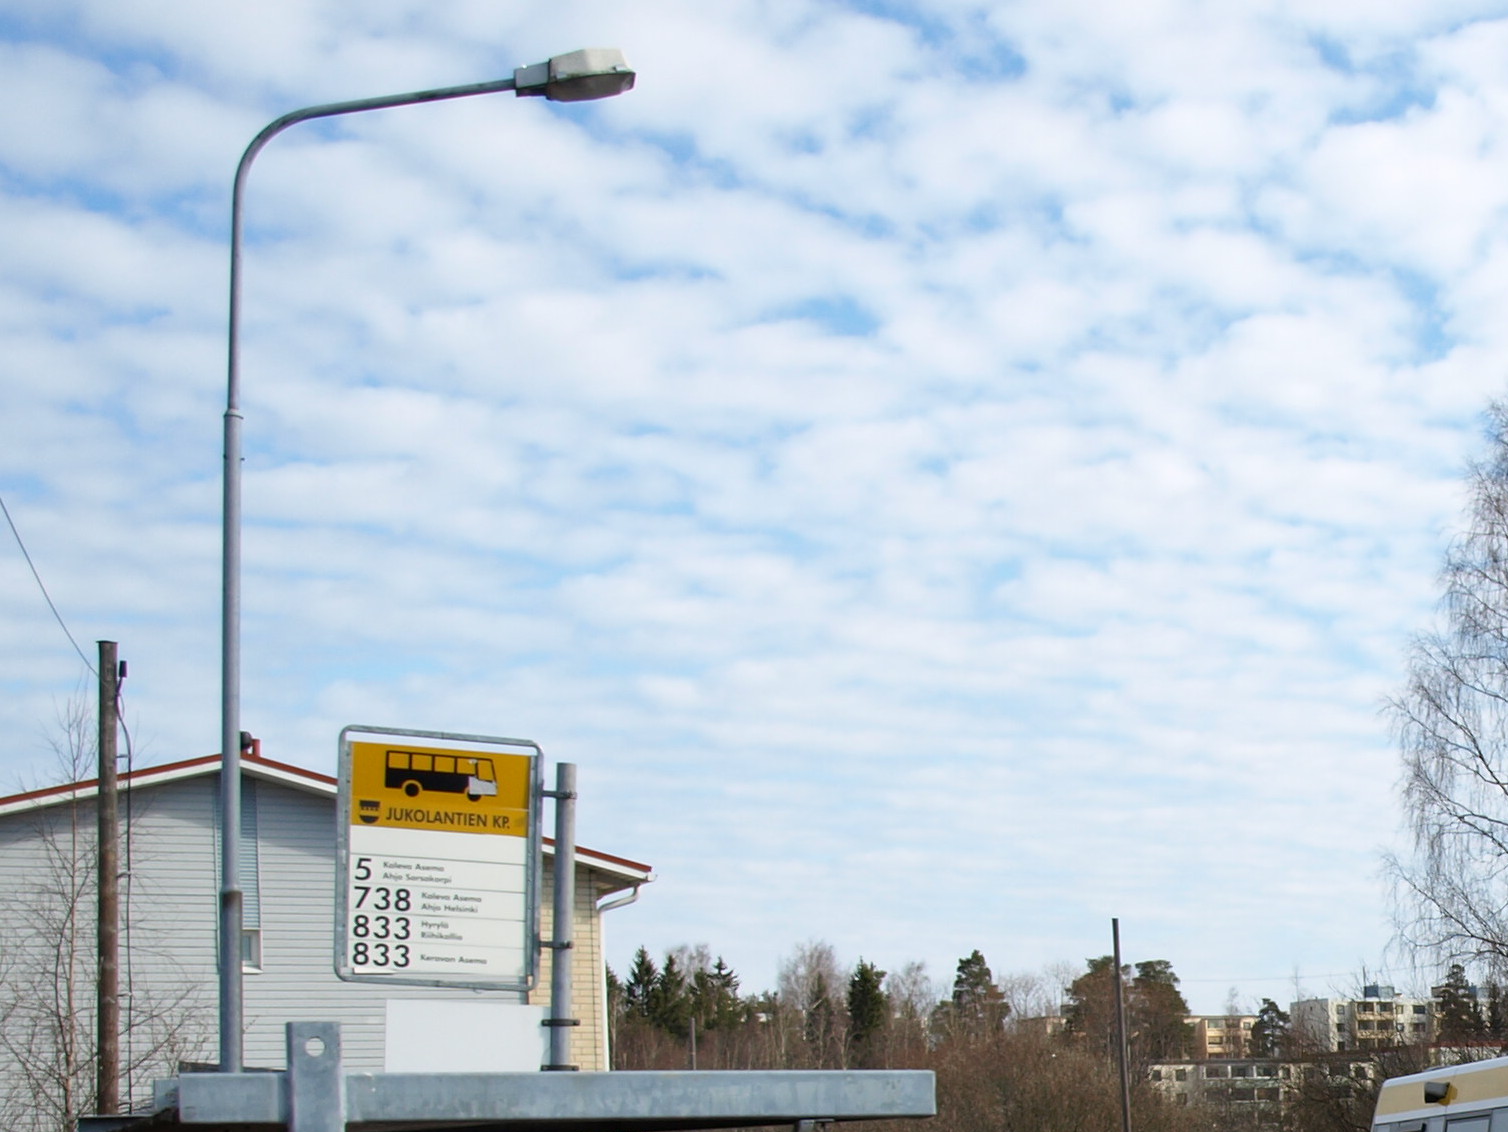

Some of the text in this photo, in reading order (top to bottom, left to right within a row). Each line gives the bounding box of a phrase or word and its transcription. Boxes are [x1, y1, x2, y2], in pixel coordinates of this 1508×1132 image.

[385, 807, 511, 829] JUKOLANTIEN KP.
[354, 858, 372, 881] 5
[353, 885, 412, 912] 738
[444, 904, 479, 914] Helsinki
[352, 914, 411, 941] 833
[352, 942, 411, 968] 833
